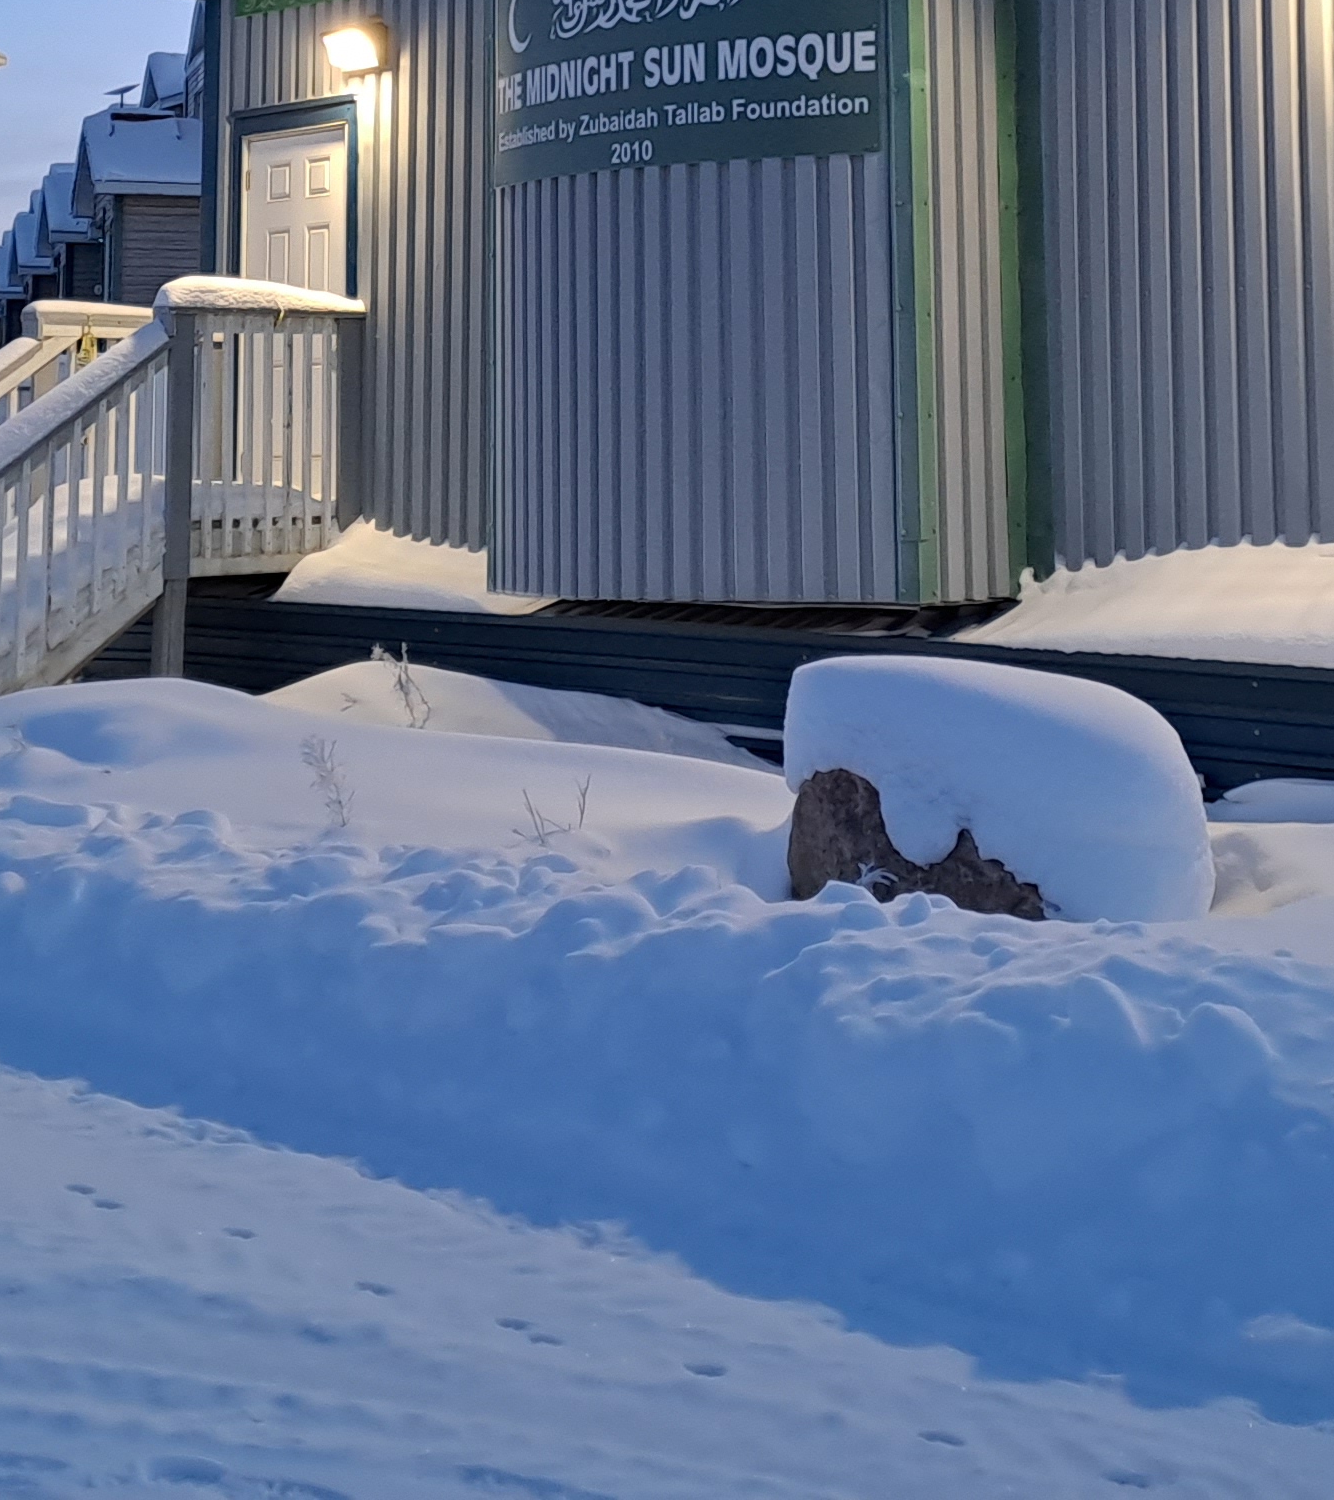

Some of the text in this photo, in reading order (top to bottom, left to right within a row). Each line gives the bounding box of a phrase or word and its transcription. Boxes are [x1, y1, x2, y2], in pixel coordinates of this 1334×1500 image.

[498, 30, 876, 114] THE MIDNIGHT SUN MOSQUE
[498, 93, 869, 150] Established by Zubaidah Tallab Foundation
[611, 139, 653, 164] 2010
